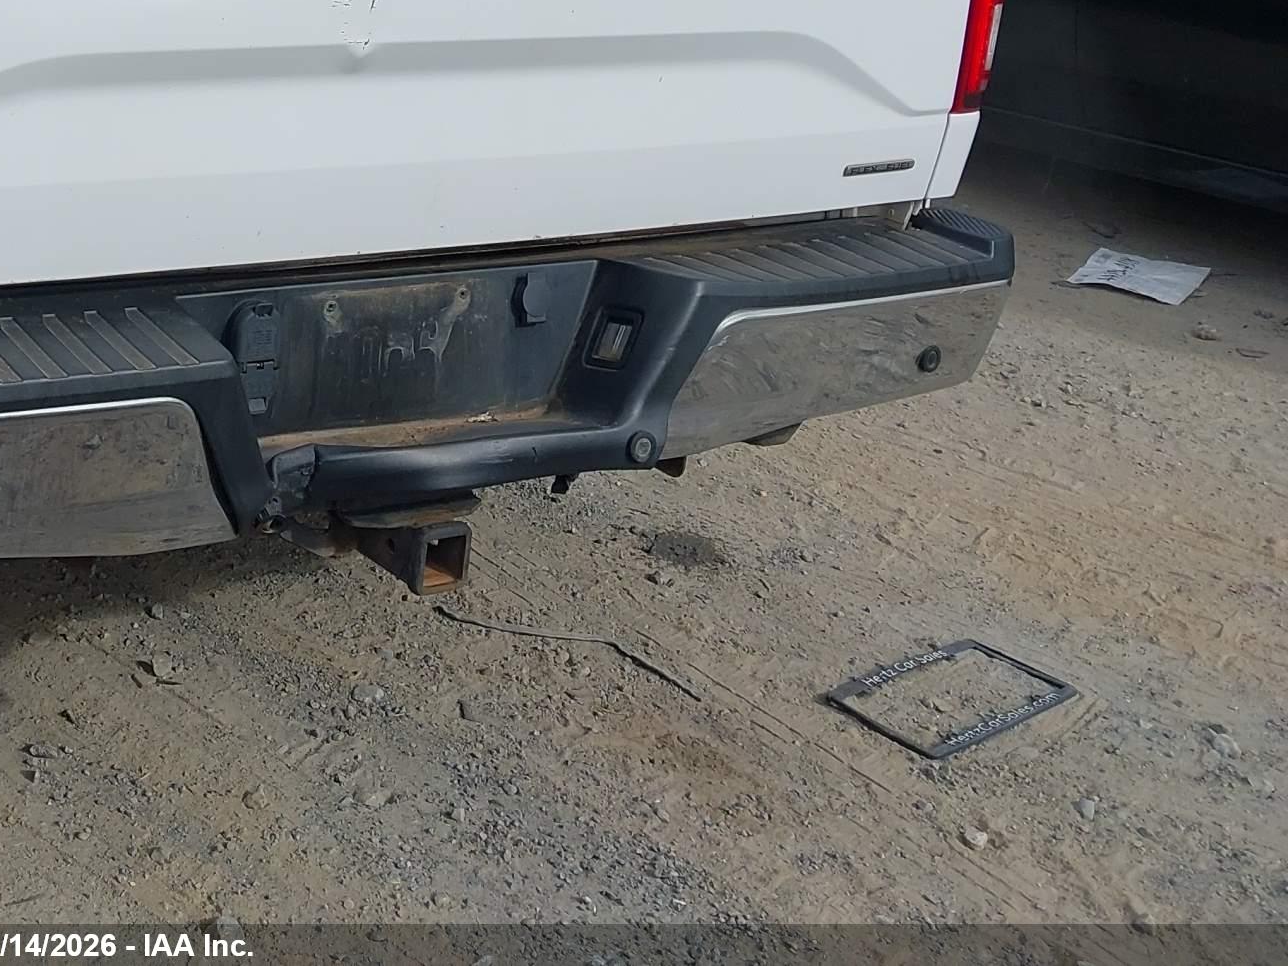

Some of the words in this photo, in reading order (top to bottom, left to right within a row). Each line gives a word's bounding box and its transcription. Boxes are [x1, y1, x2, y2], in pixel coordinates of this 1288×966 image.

[861, 668, 897, 687] Hertz
[894, 660, 918, 672] Car
[914, 650, 948, 665] Sales
[943, 692, 1062, 747] HertzCarSales.com
